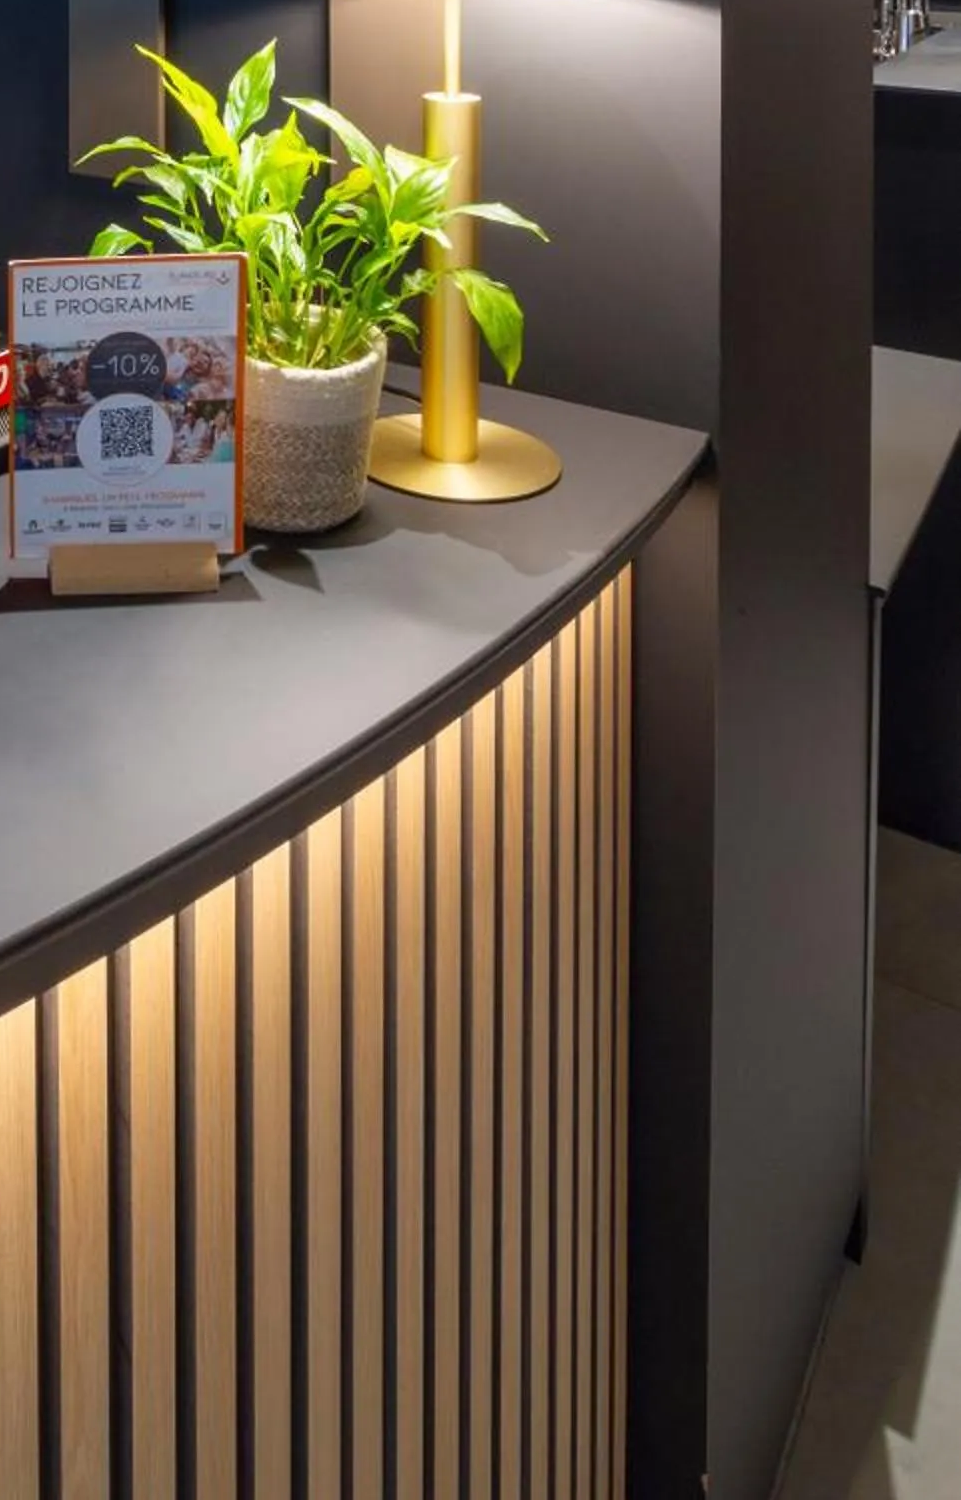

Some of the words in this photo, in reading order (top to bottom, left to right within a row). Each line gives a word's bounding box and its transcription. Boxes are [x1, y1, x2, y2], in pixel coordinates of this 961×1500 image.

[21, 273, 143, 294] REJOIGNEZ
[21, 299, 48, 318] LE
[54, 295, 195, 316] PROGRAMME
